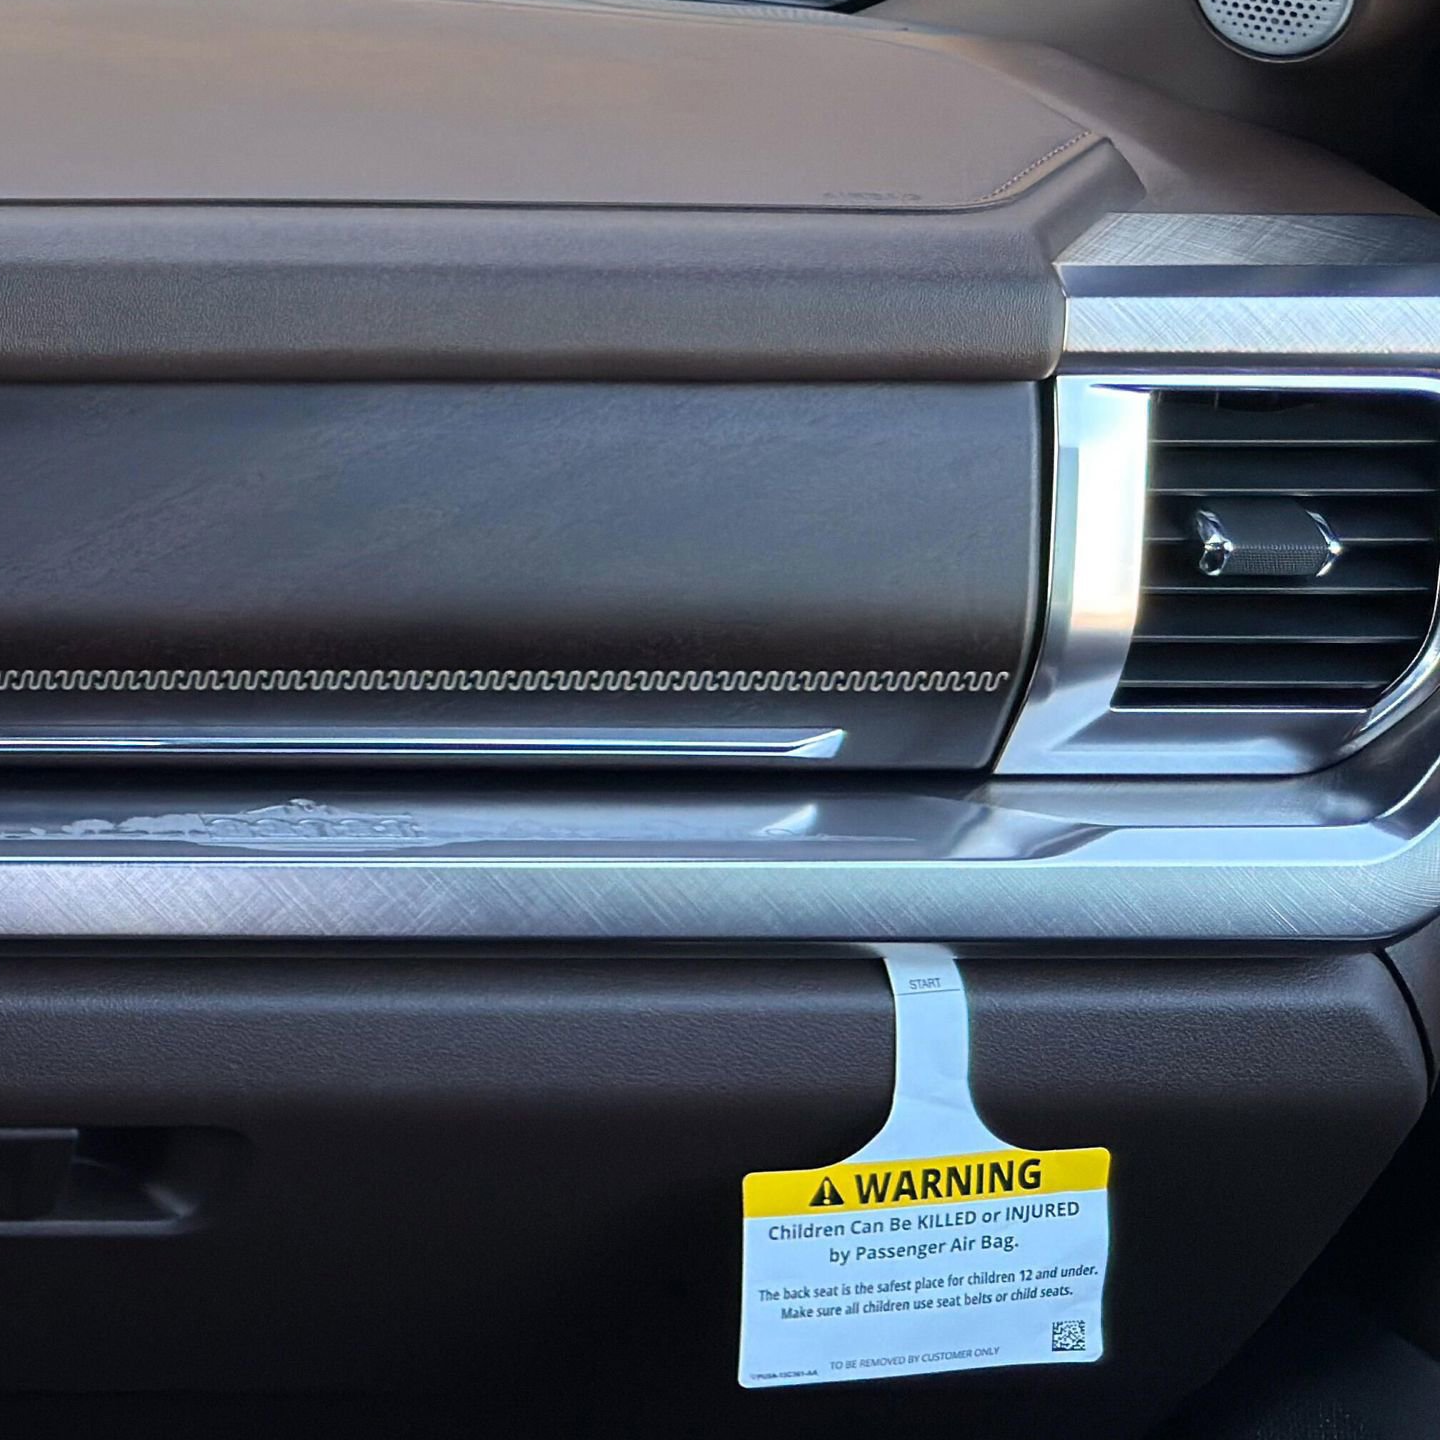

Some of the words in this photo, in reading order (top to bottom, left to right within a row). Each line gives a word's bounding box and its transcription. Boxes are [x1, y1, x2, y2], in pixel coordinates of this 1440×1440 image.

[909, 978, 941, 989] START
[855, 1159, 1041, 1204] WARNING
[769, 1221, 845, 1240] Children
[850, 1219, 884, 1236] Can
[890, 1216, 912, 1232] Be
[918, 1211, 976, 1229] KILLED
[982, 1211, 1001, 1224] or
[1006, 1202, 1079, 1221] INJURED
[829, 1245, 850, 1264] by
[855, 1238, 946, 1261] Passenger
[950, 1236, 976, 1252] Air
[981, 1233, 1019, 1252] Bag.
[759, 1289, 780, 1301] The
[783, 1286, 811, 1300] back
[814, 1286, 838, 1298] seat
[841, 1283, 851, 1296] is
[855, 1282, 874, 1295] the
[877, 1279, 912, 1293] safest
[915, 1277, 944, 1293] place
[948, 1274, 964, 1287] for
[967, 1271, 1015, 1286] children
[1020, 1269, 1032, 1282] 12
[1035, 1267, 1057, 1281] and
[1061, 1264, 1098, 1278] under.
[781, 1307, 813, 1319] Make
[816, 1305, 842, 1317] sure
[845, 1302, 859, 1315] all
[863, 1299, 910, 1314] children
[913, 1298, 933, 1310] use
[936, 1295, 961, 1309] seat
[964, 1292, 992, 1306] belts
[996, 1293, 1008, 1303] or
[1011, 1287, 1037, 1302] child
[1040, 1285, 1073, 1299] seats.
[830, 1360, 843, 1370] TO
[846, 1359, 857, 1369] BE
[859, 1356, 906, 1367] REMOVED
[908, 1354, 920, 1364] BY
[922, 1349, 973, 1363] CUSTOMER
[975, 1347, 1000, 1358] ONLY
